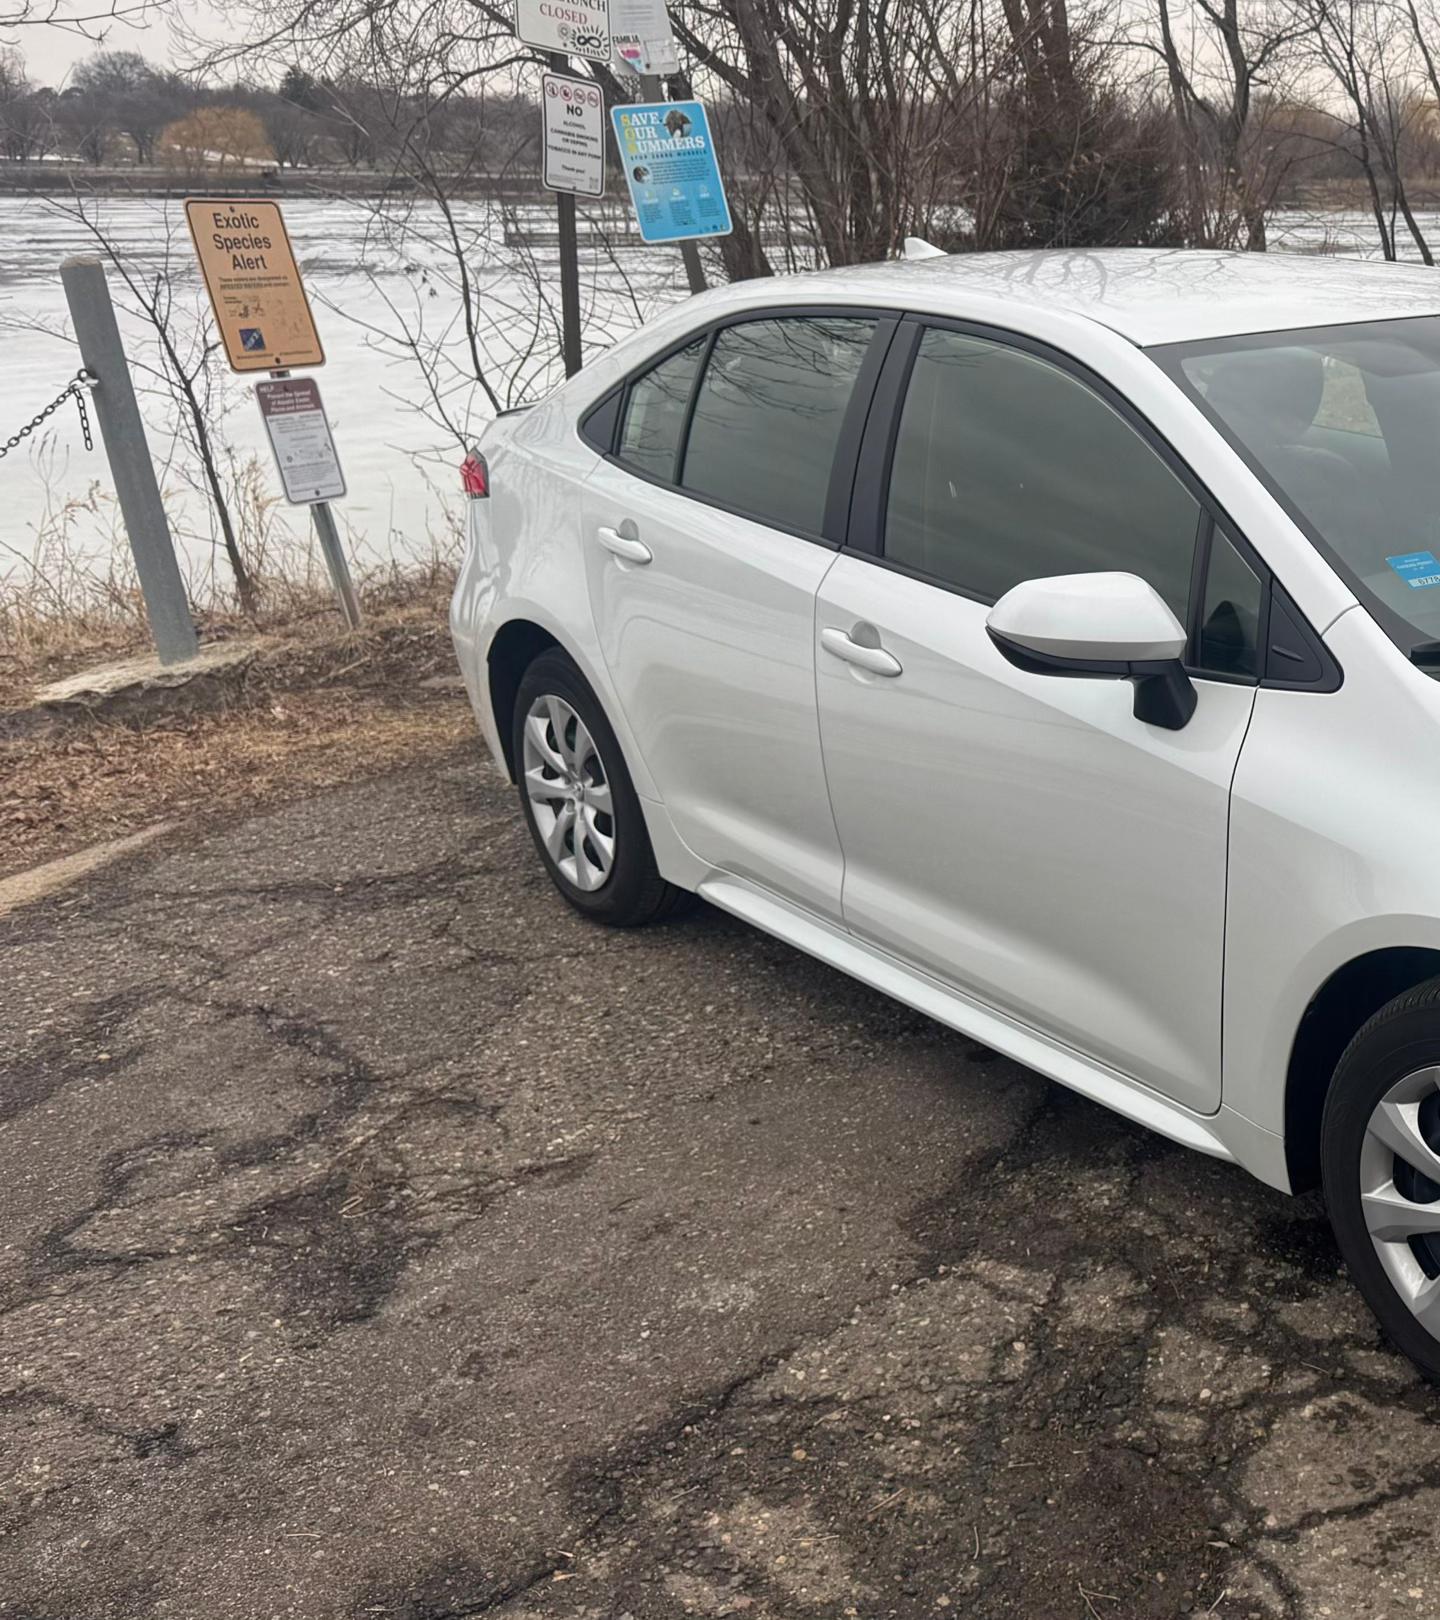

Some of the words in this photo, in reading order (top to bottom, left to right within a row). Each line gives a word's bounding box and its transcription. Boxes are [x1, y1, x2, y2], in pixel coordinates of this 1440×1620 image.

[539, 3, 588, 24] CLOSED
[559, 0, 606, 12] NCH
[567, 104, 583, 117] NO
[624, 126, 658, 141] OUR
[212, 212, 260, 229] Exotic
[213, 233, 272, 253] Species
[232, 254, 268, 271] Alert
